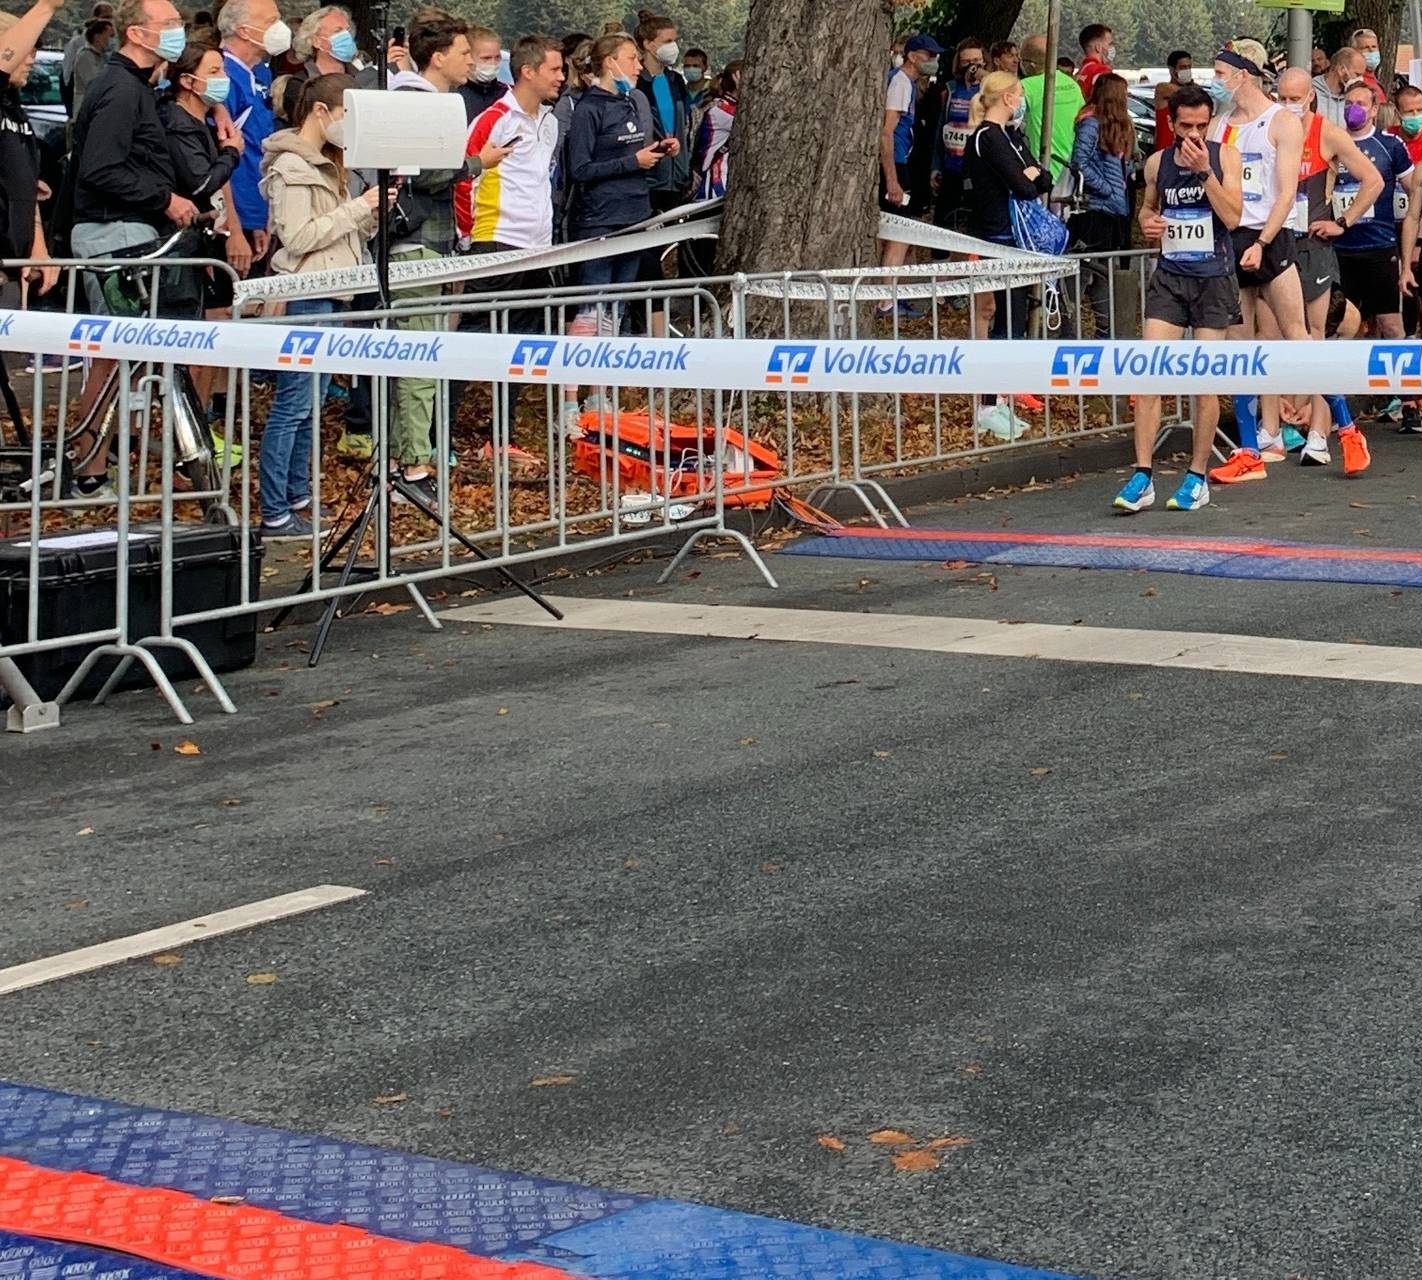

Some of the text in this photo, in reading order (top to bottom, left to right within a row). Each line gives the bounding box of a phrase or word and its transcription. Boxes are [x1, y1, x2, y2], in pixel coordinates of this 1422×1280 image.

[1168, 225, 1205, 239] 5170
[111, 322, 220, 350] Volksbank
[326, 332, 443, 362] Volksbank
[562, 341, 690, 371] Volksbank
[822, 344, 965, 375] Volksbank
[1112, 344, 1269, 378] Volksbank
